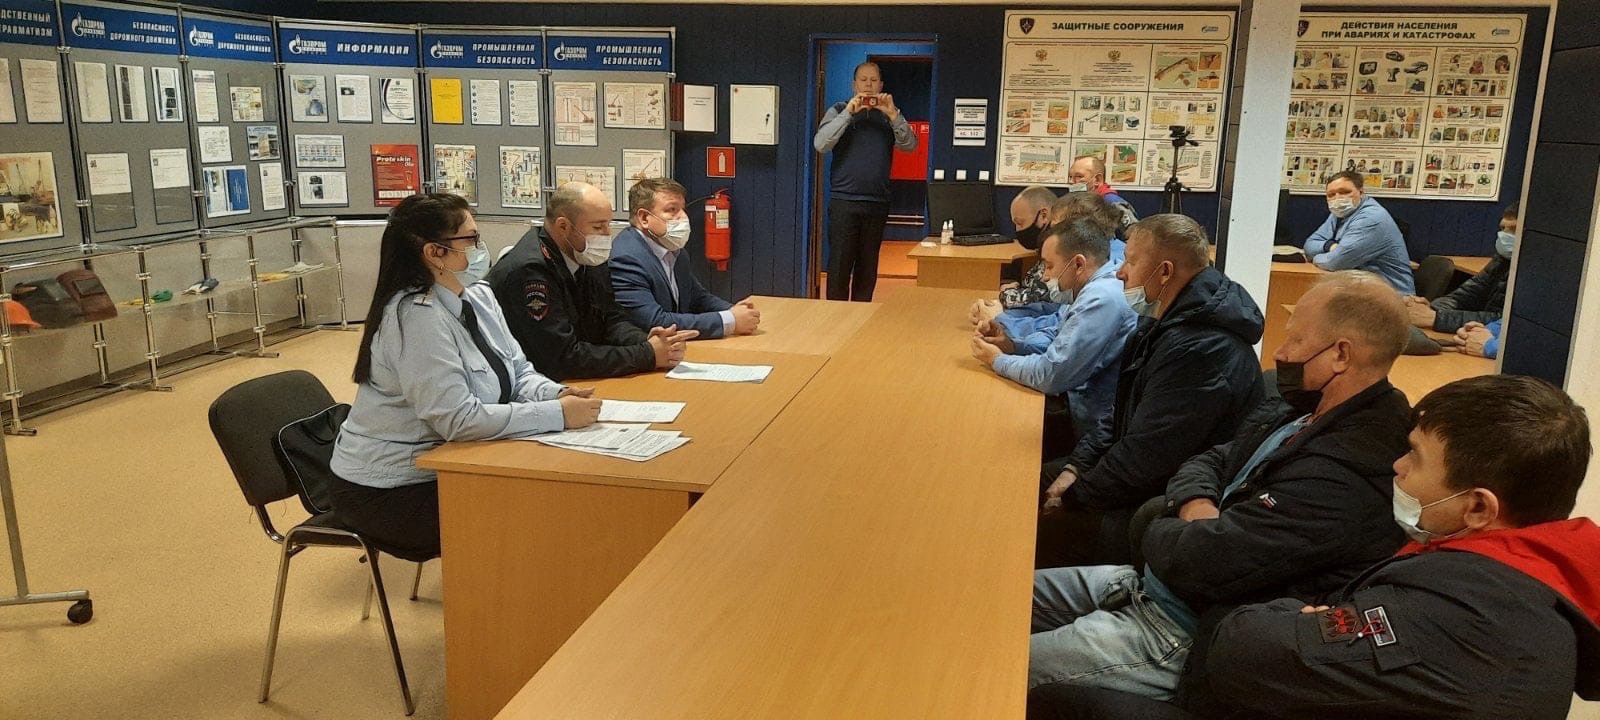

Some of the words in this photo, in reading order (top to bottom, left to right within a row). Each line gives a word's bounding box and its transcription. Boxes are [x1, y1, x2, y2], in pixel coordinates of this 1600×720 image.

[132, 21, 176, 33] БЕЗОПАСНОСТЬ
[1052, 22, 1110, 31] ЗАЩИТНЫЕ
[1113, 22, 1184, 31] СООРУЖЕНИЯ
[1341, 21, 1394, 30] ДЕЙСТВИЯ
[1397, 22, 1458, 30] НАСЕЛЕНИЯ
[110, 32, 145, 42] ДОРОЖНОГО
[145, 36, 177, 45] ДВИЖЕНИЯ
[234, 32, 271, 42] БЕЗОПАСНОСТЬ
[1344, 31, 1390, 39] АВАРИЯХ
[1402, 32, 1476, 40] КАТАСТРОФАХ
[337, 43, 410, 55] ИНФОРМАЦИЯ
[472, 43, 535, 52] ПРОМЫШЛЕННАЯ
[596, 45, 663, 55] ПРОМЫШЛЕННАЯ
[477, 56, 536, 65] БЕЗОПАСНОСТЬ
[602, 57, 662, 66] БЕЗОПАСНОСТЬ
